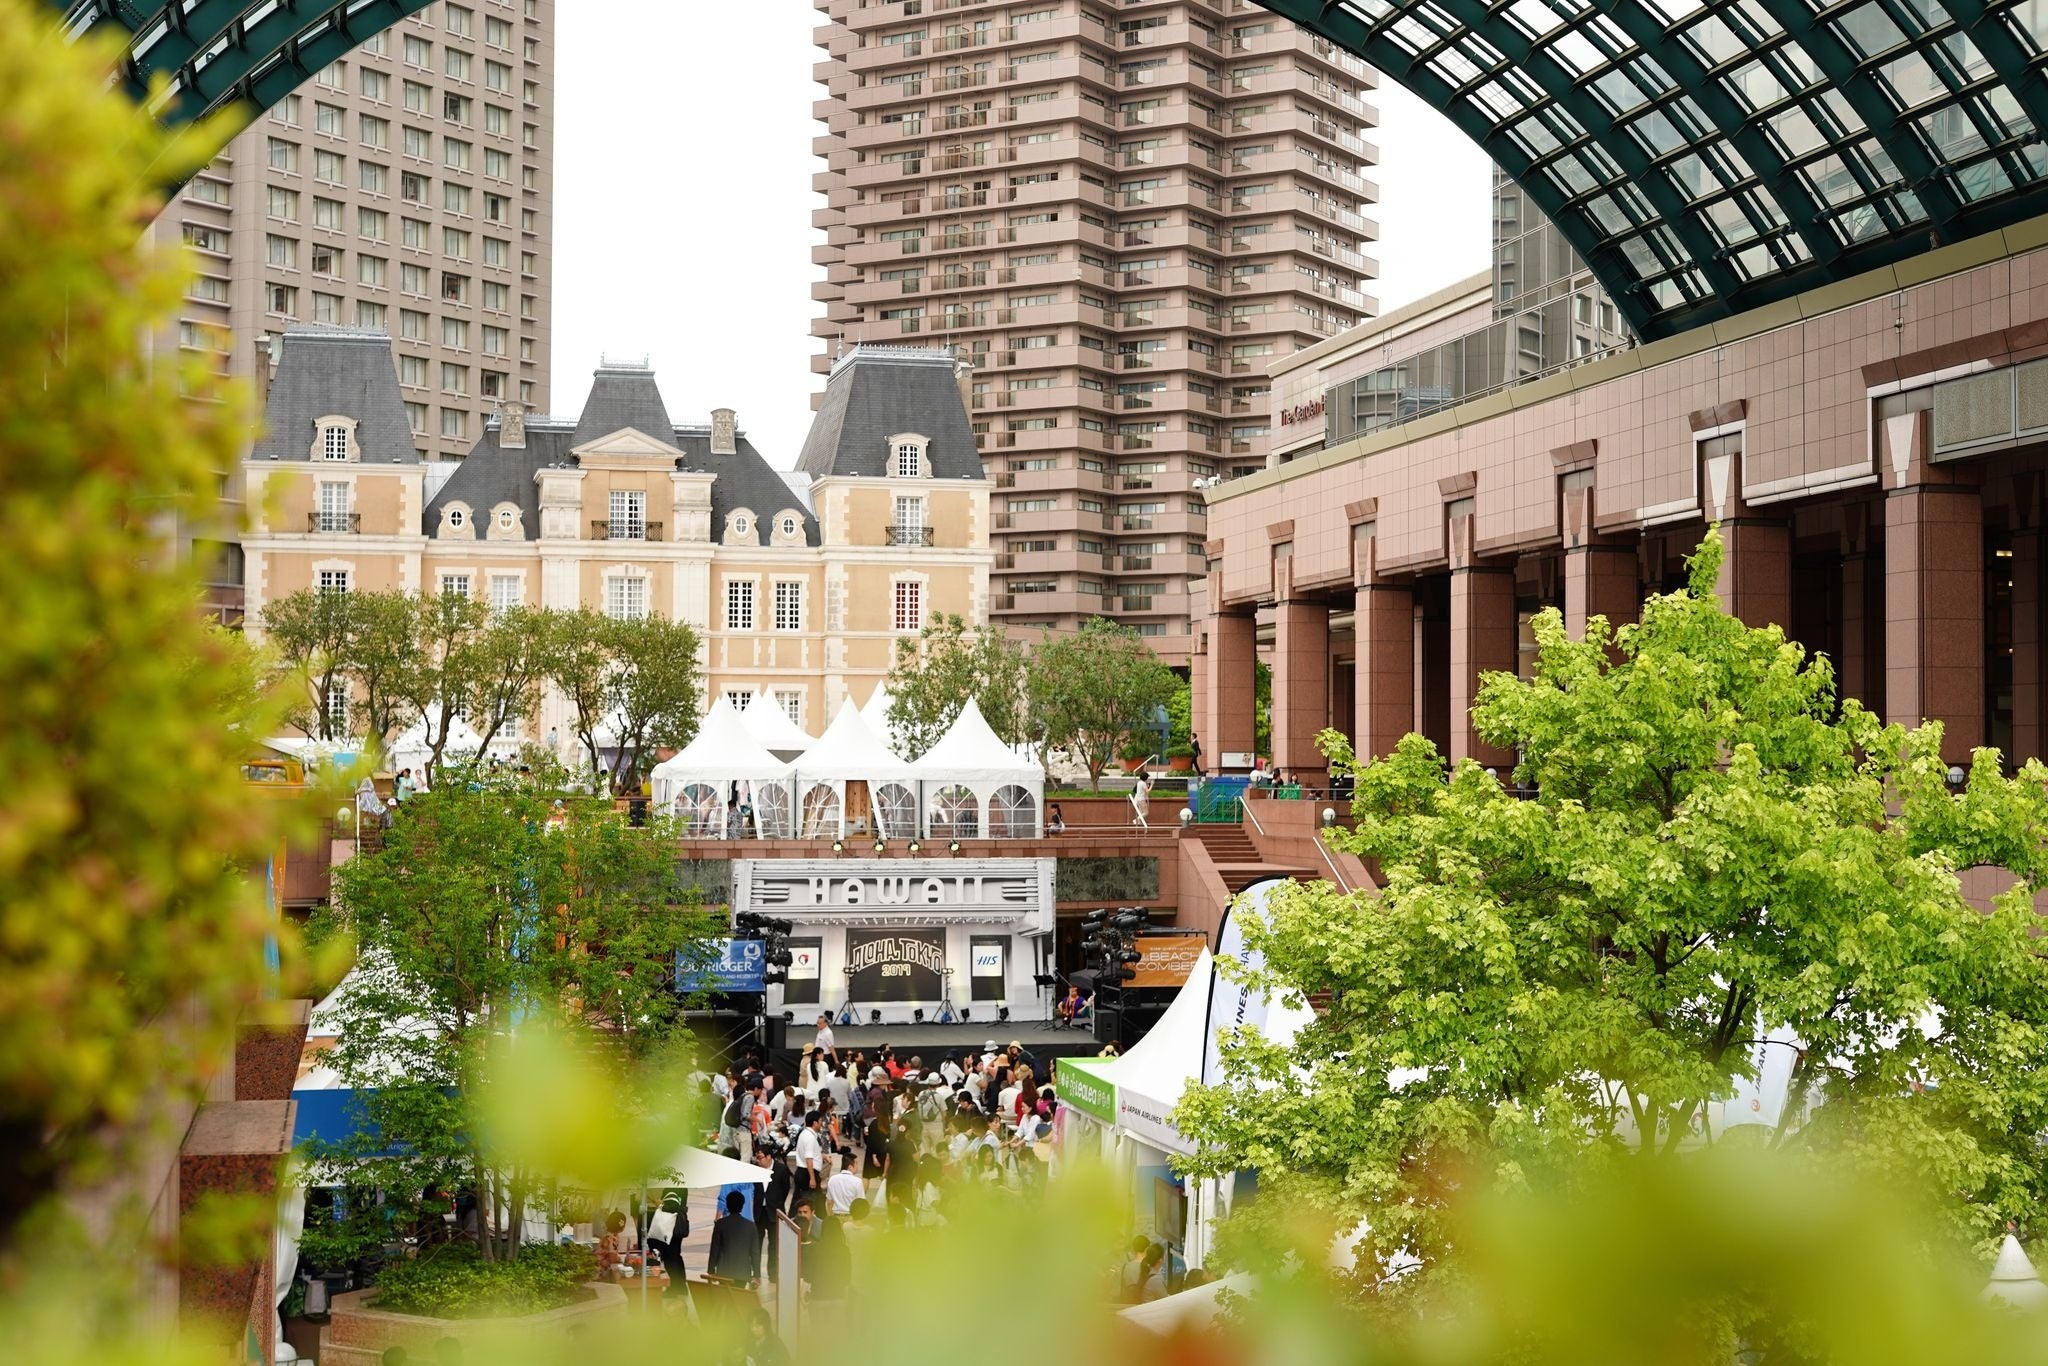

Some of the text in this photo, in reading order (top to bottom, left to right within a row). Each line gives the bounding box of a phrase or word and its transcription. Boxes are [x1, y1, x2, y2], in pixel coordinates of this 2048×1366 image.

[808, 877, 983, 904] HAWAII
[899, 938, 944, 976] TOKYO
[881, 963, 911, 976] 2019
[1127, 1104, 1162, 1125] JAPAN AIRLINES
